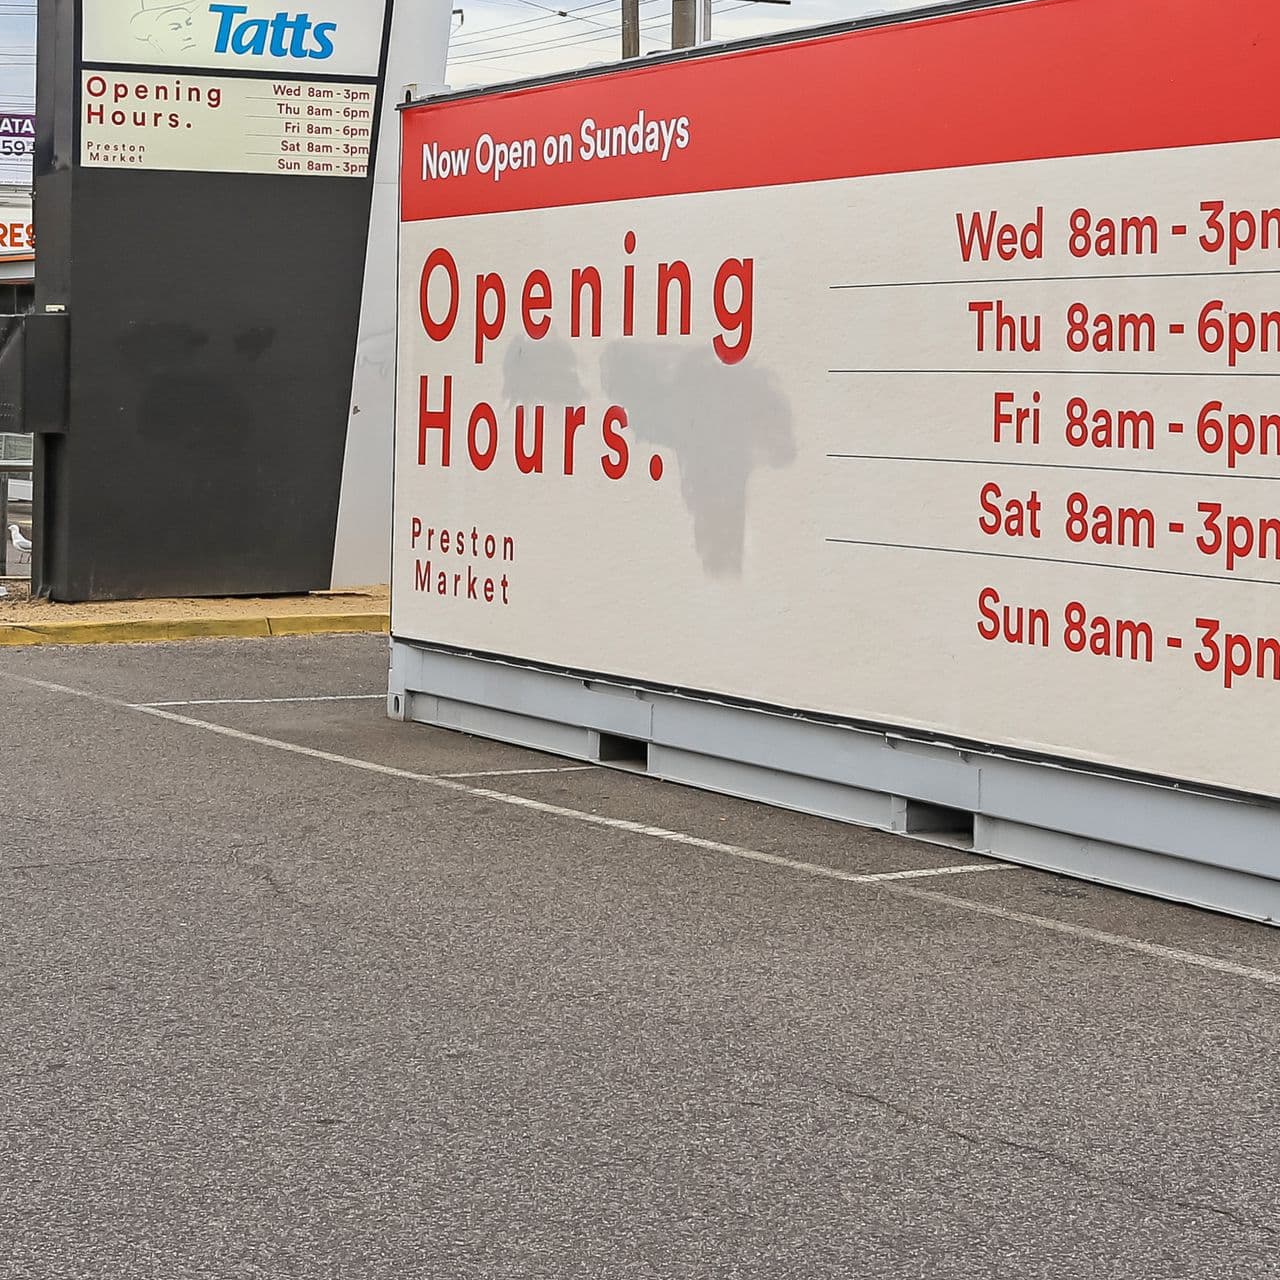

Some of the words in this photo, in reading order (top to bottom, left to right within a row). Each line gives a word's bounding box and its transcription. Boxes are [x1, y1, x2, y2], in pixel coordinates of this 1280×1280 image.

[208, 3, 337, 60] Tatts
[86, 76, 223, 108] Opening
[273, 84, 301, 97] Wed
[308, 87, 333, 98] 8am
[343, 89, 370, 101] 3pm
[277, 103, 300, 115] Thu
[307, 105, 332, 116] 8am
[343, 107, 369, 120] 6pm
[86, 104, 193, 129] Hours.
[285, 122, 300, 133] Fri
[307, 123, 332, 135] 8am
[342, 125, 369, 138] 6pm
[86, 141, 146, 153] Preston
[89, 152, 144, 163] Market
[277, 159, 300, 170] Sun
[307, 160, 332, 171] 8am
[342, 162, 368, 174] 3pm
[281, 140, 300, 152] Sat
[307, 142, 332, 153] 8am
[343, 144, 369, 156] 3pm
[421, 142, 470, 181] Now
[475, 133, 536, 182] Open
[543, 137, 573, 165] on
[579, 109, 690, 162] Sundays
[955, 206, 1044, 262] Wed
[1068, 207, 1158, 258] 8am
[419, 230, 754, 365] Opening
[968, 300, 1042, 352] Thu
[1066, 302, 1156, 352] 8am
[417, 375, 664, 481] Hours.
[993, 391, 1041, 444] Fri
[1065, 397, 1155, 449] 8am
[979, 482, 1042, 538] Sat
[1066, 492, 1155, 548] 8am
[412, 517, 515, 561] Preston
[414, 559, 510, 605] Market
[977, 587, 1049, 647] Sun
[1063, 601, 1153, 662] 8am
